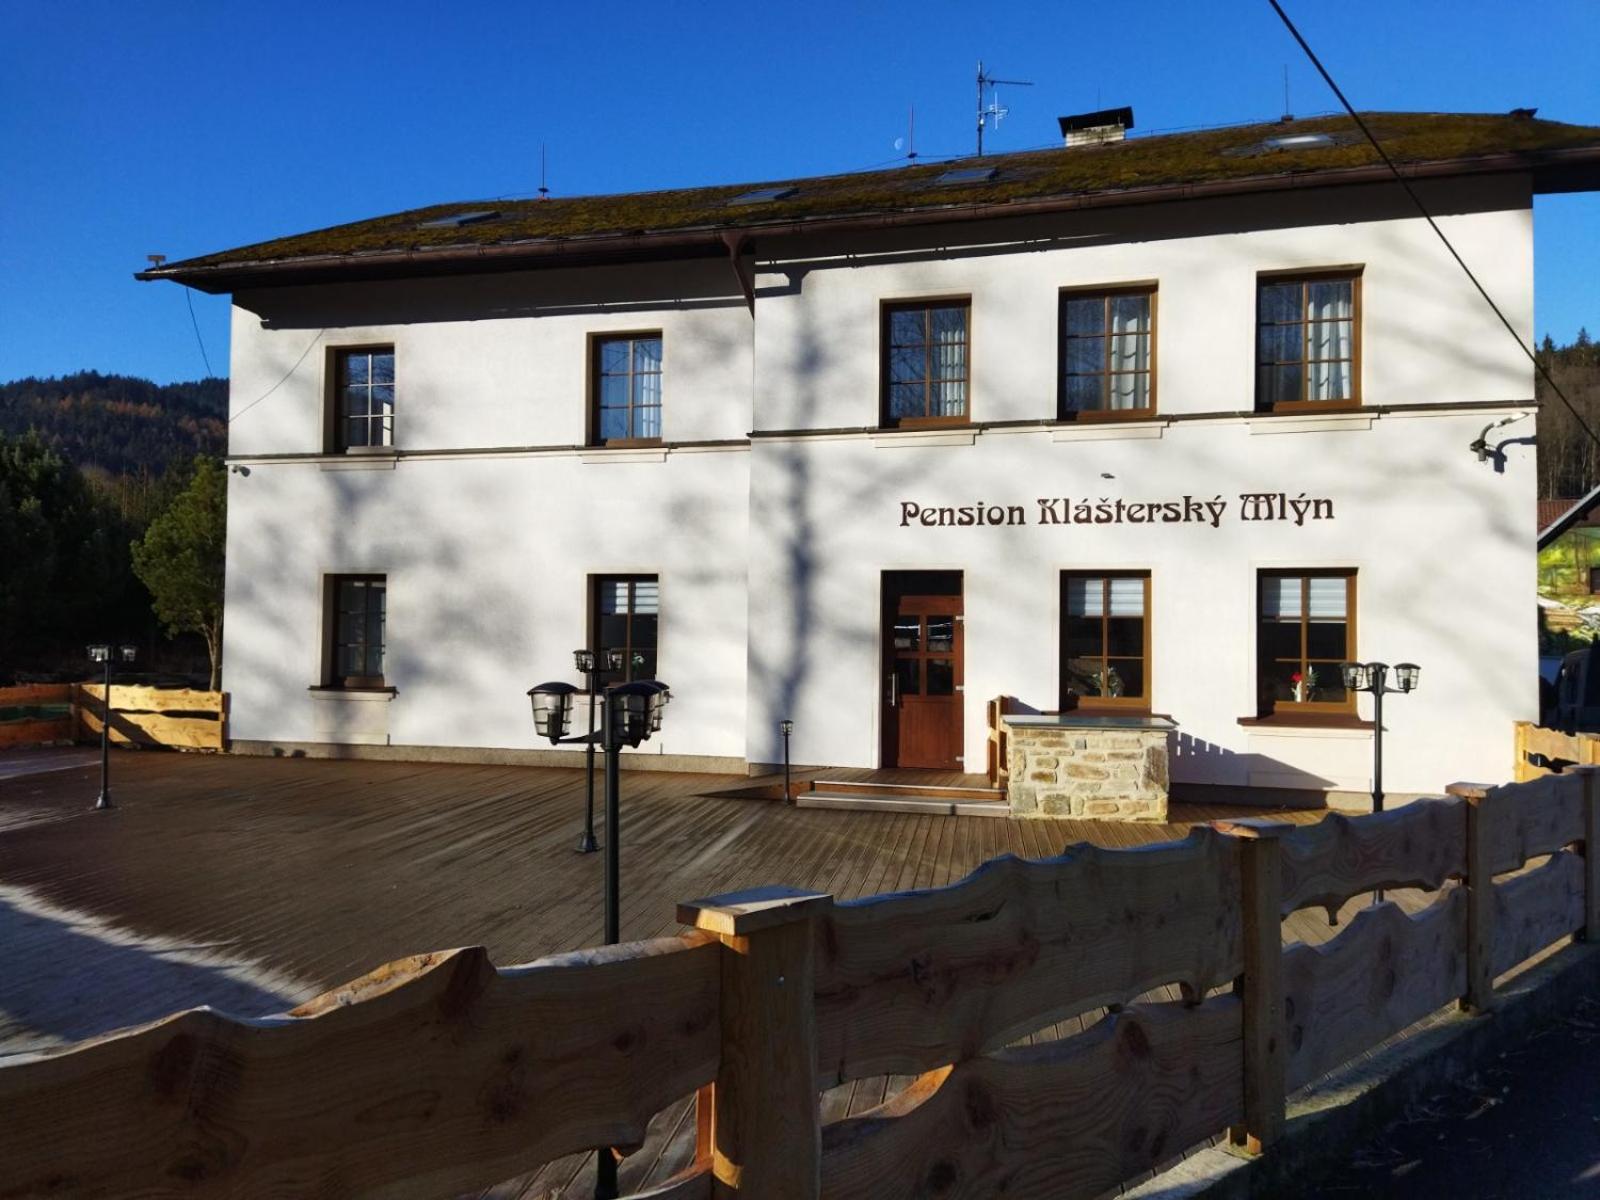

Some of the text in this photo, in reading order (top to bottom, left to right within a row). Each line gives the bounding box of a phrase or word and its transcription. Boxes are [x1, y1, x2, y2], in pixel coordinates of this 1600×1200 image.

[899, 492, 1335, 529] Pension Klášterský Mlýn
